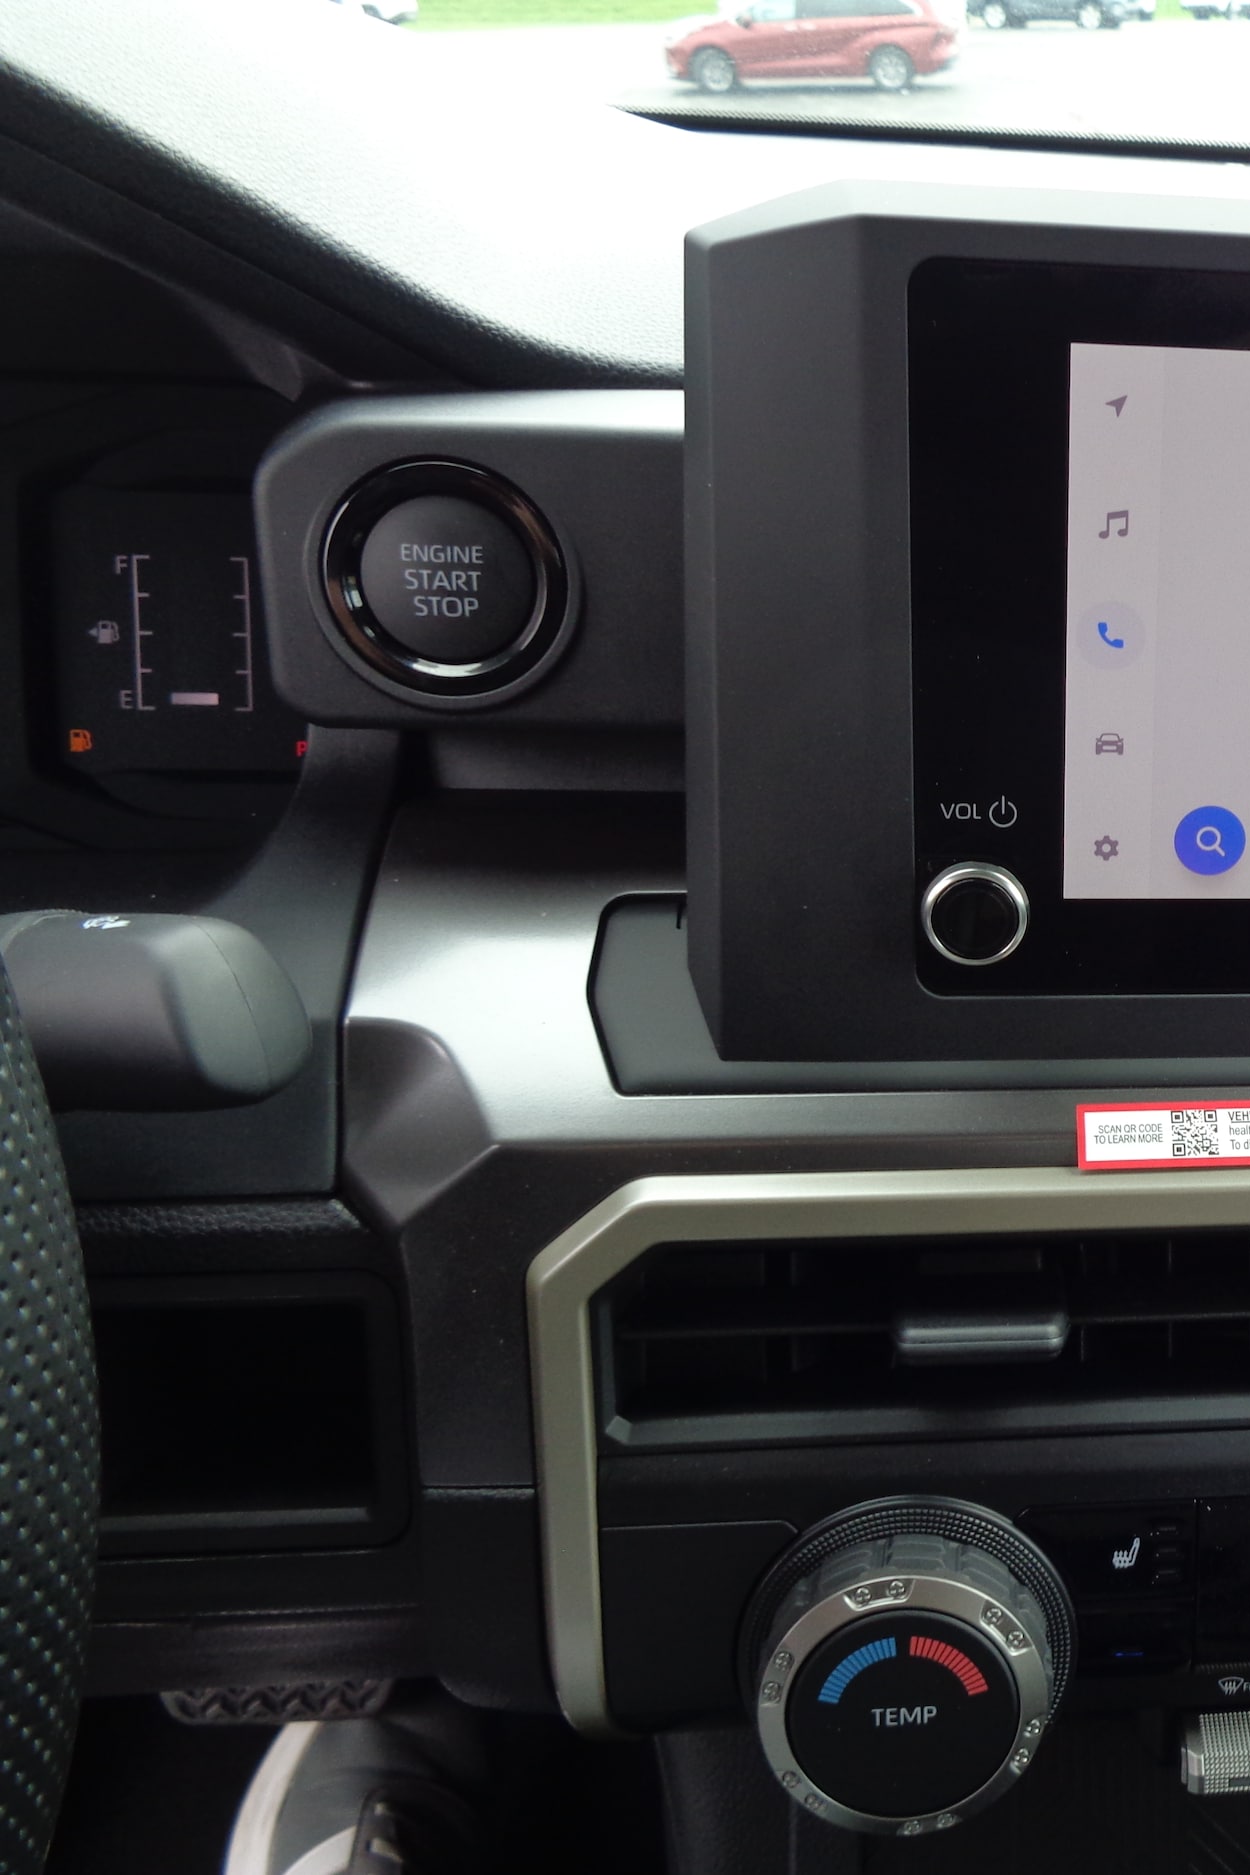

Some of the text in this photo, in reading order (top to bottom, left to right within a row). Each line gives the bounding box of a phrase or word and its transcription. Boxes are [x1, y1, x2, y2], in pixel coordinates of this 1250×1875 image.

[400, 542, 485, 566] ENGINE
[114, 555, 128, 574] F
[404, 568, 482, 591] START
[413, 595, 480, 618] STOP
[119, 690, 133, 709] E
[940, 802, 982, 820] VOL
[1098, 1123, 1163, 1134] SCAN QR CODE
[1094, 1133, 1163, 1144] TO LEARN MORE
[1229, 1139, 1241, 1150] To
[871, 1705, 937, 1727] TEMP
